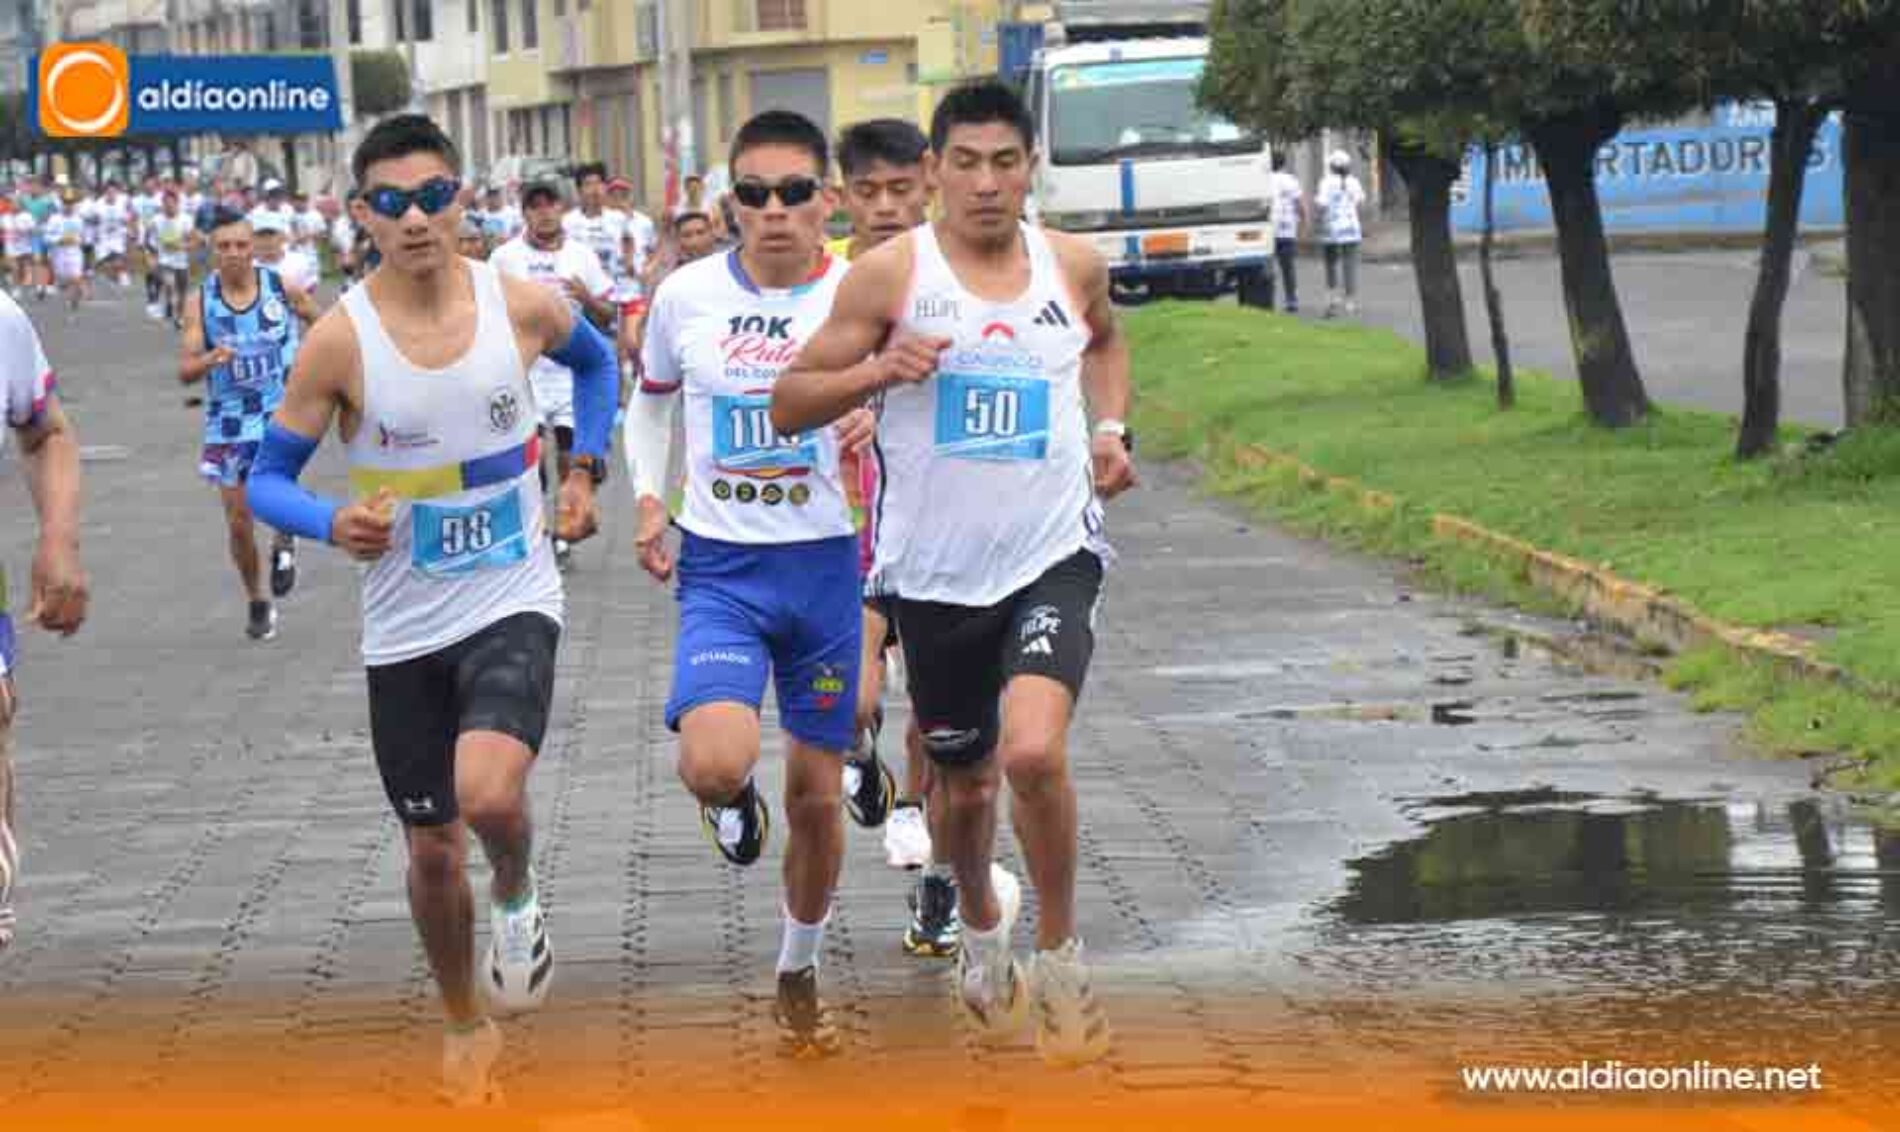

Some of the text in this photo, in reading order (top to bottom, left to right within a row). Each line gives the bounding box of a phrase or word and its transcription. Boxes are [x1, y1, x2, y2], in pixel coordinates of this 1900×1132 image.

[728, 315, 793, 340] 10K
[730, 408, 799, 449] 10
[965, 387, 1019, 436] 50
[442, 509, 492, 555] 58
